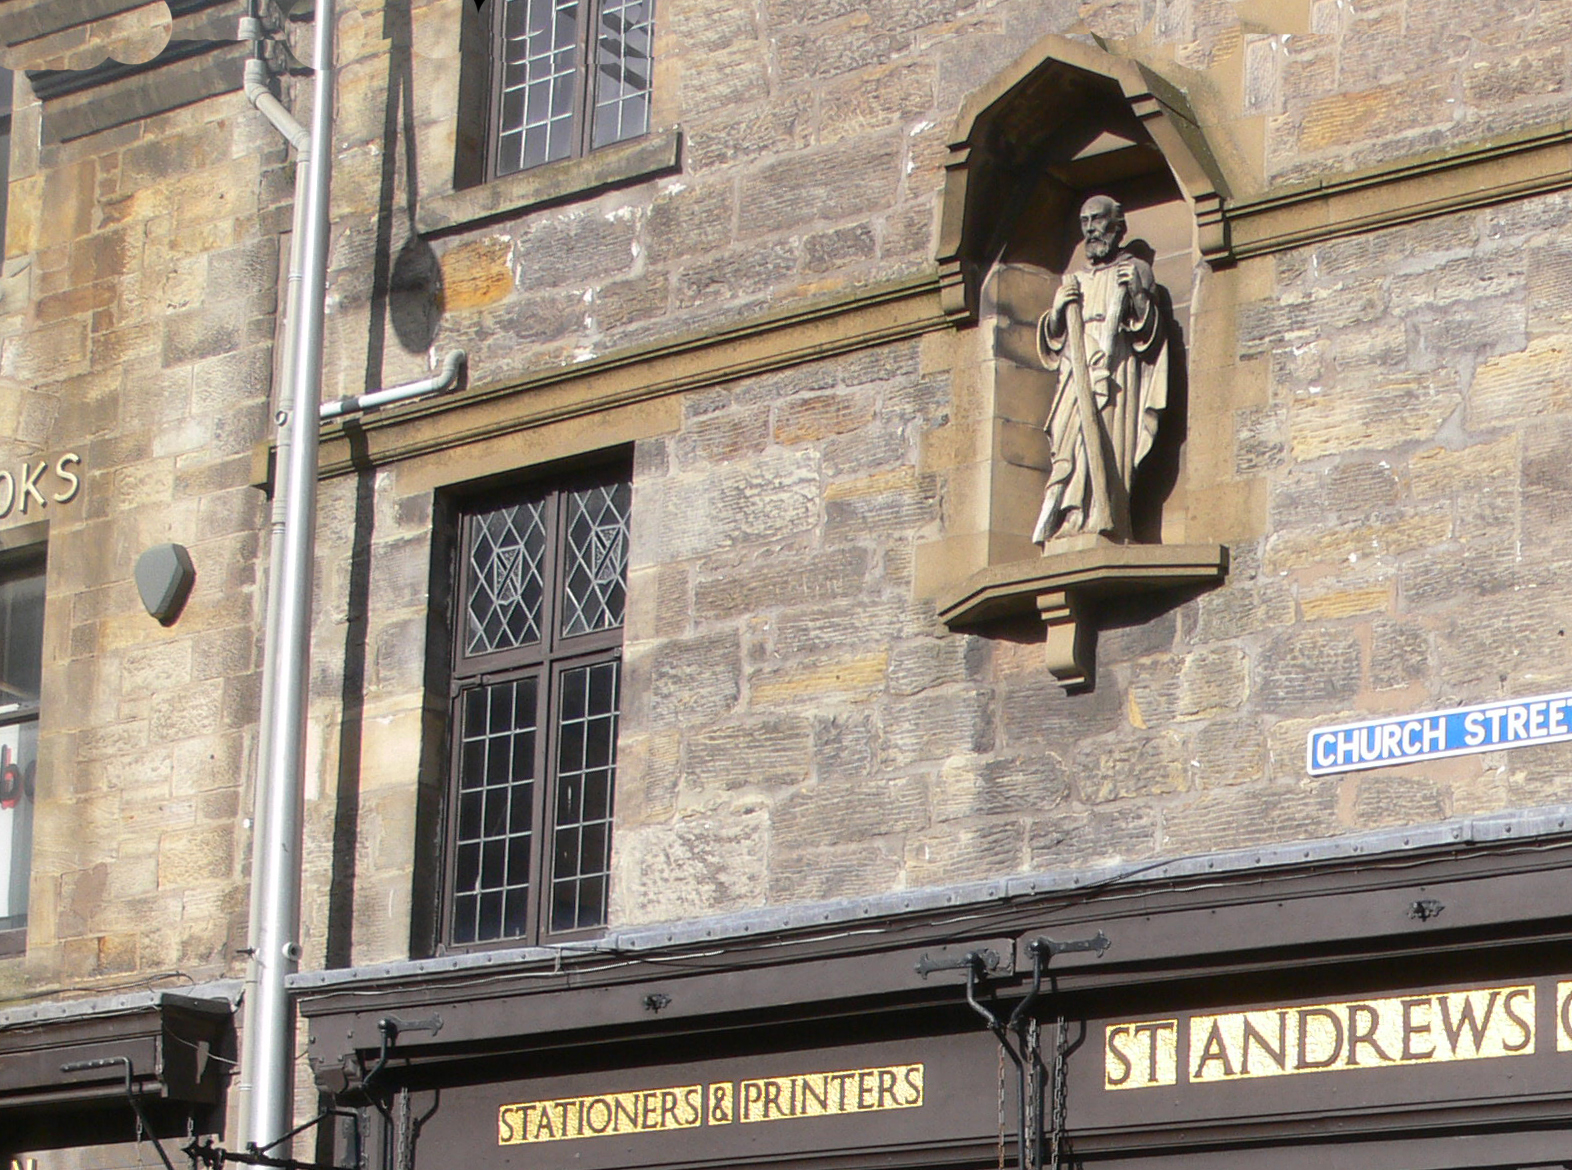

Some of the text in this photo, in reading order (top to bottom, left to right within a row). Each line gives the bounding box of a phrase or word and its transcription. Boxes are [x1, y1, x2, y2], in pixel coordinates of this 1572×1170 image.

[1316, 716, 1447, 767] CHURCH
[1106, 1023, 1177, 1087] ST
[1193, 987, 1534, 1079] ANDREWS
[500, 1065, 922, 1143] STATIONERS & PRINTERS
